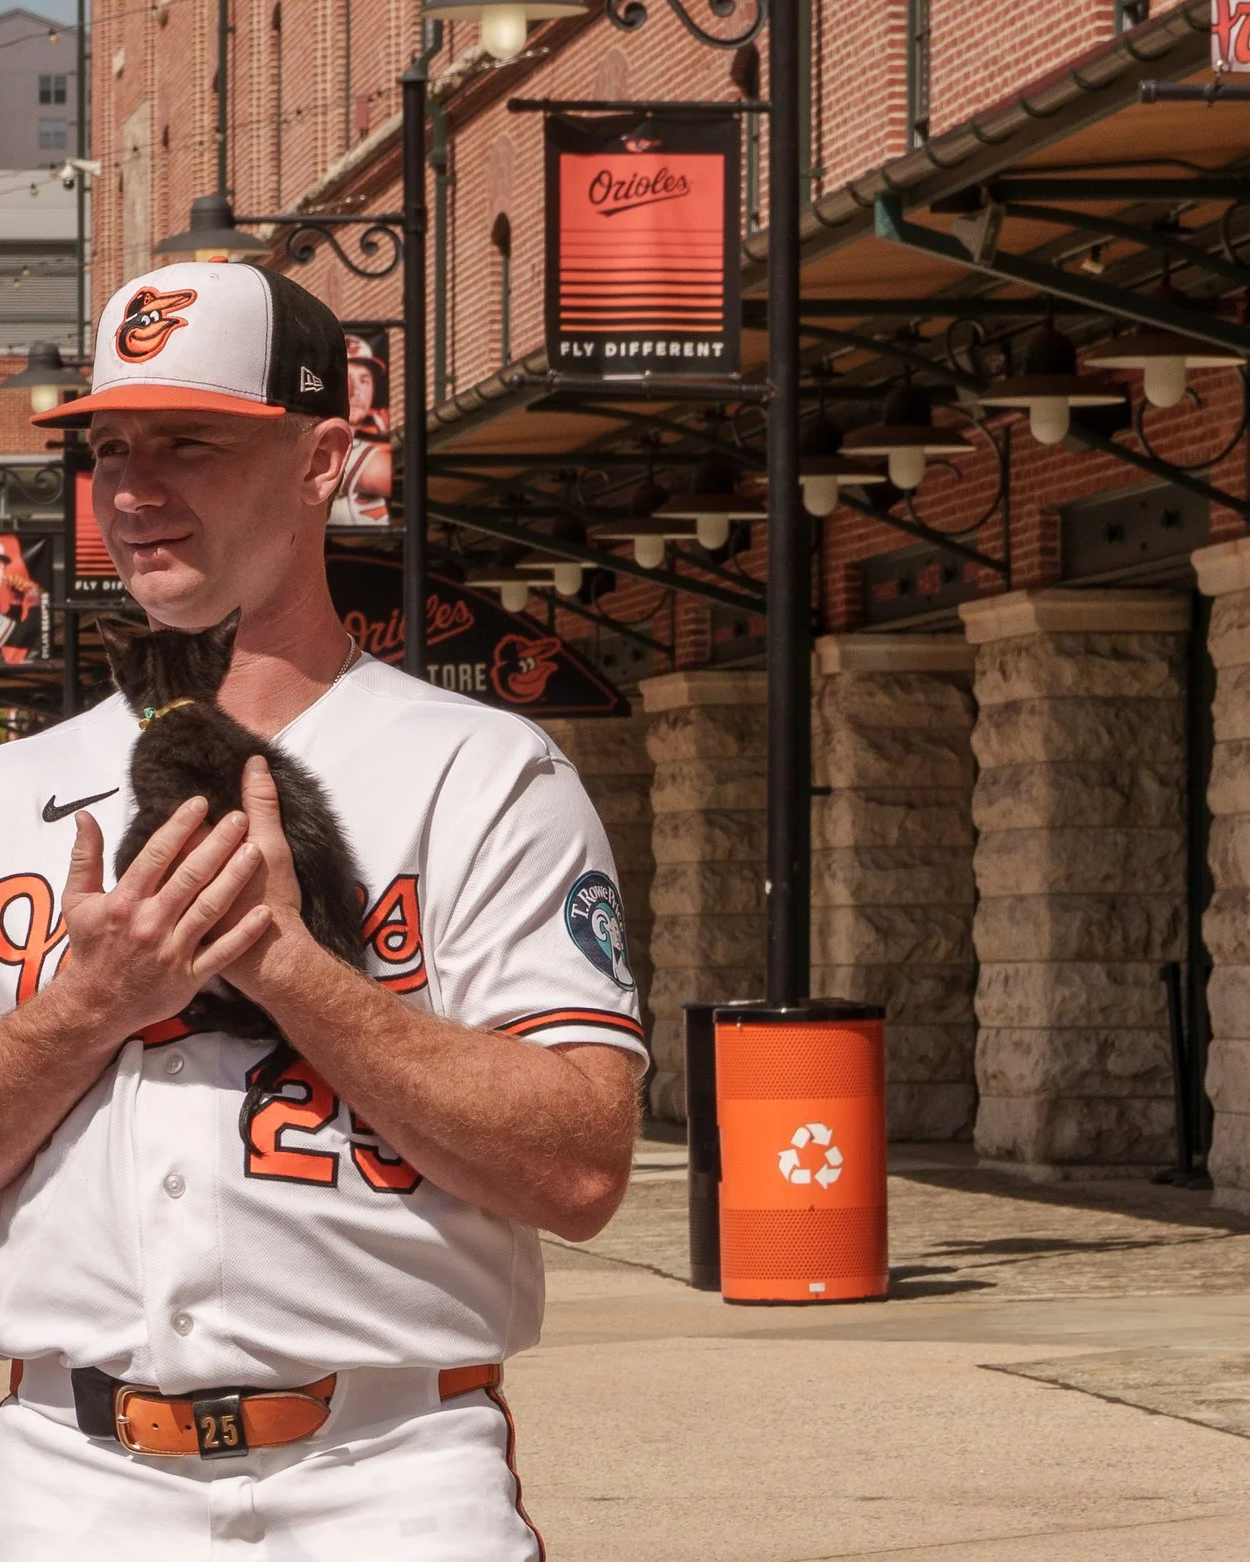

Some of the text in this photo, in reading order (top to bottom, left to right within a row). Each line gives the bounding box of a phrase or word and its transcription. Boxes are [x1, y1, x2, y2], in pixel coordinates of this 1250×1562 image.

[588, 167, 692, 217] Orioles
[560, 341, 724, 357] FLY DIFFERENT
[75, 581, 127, 591] FLY DIF
[426, 663, 487, 692] TORE
[201, 1415, 239, 1448] 25
